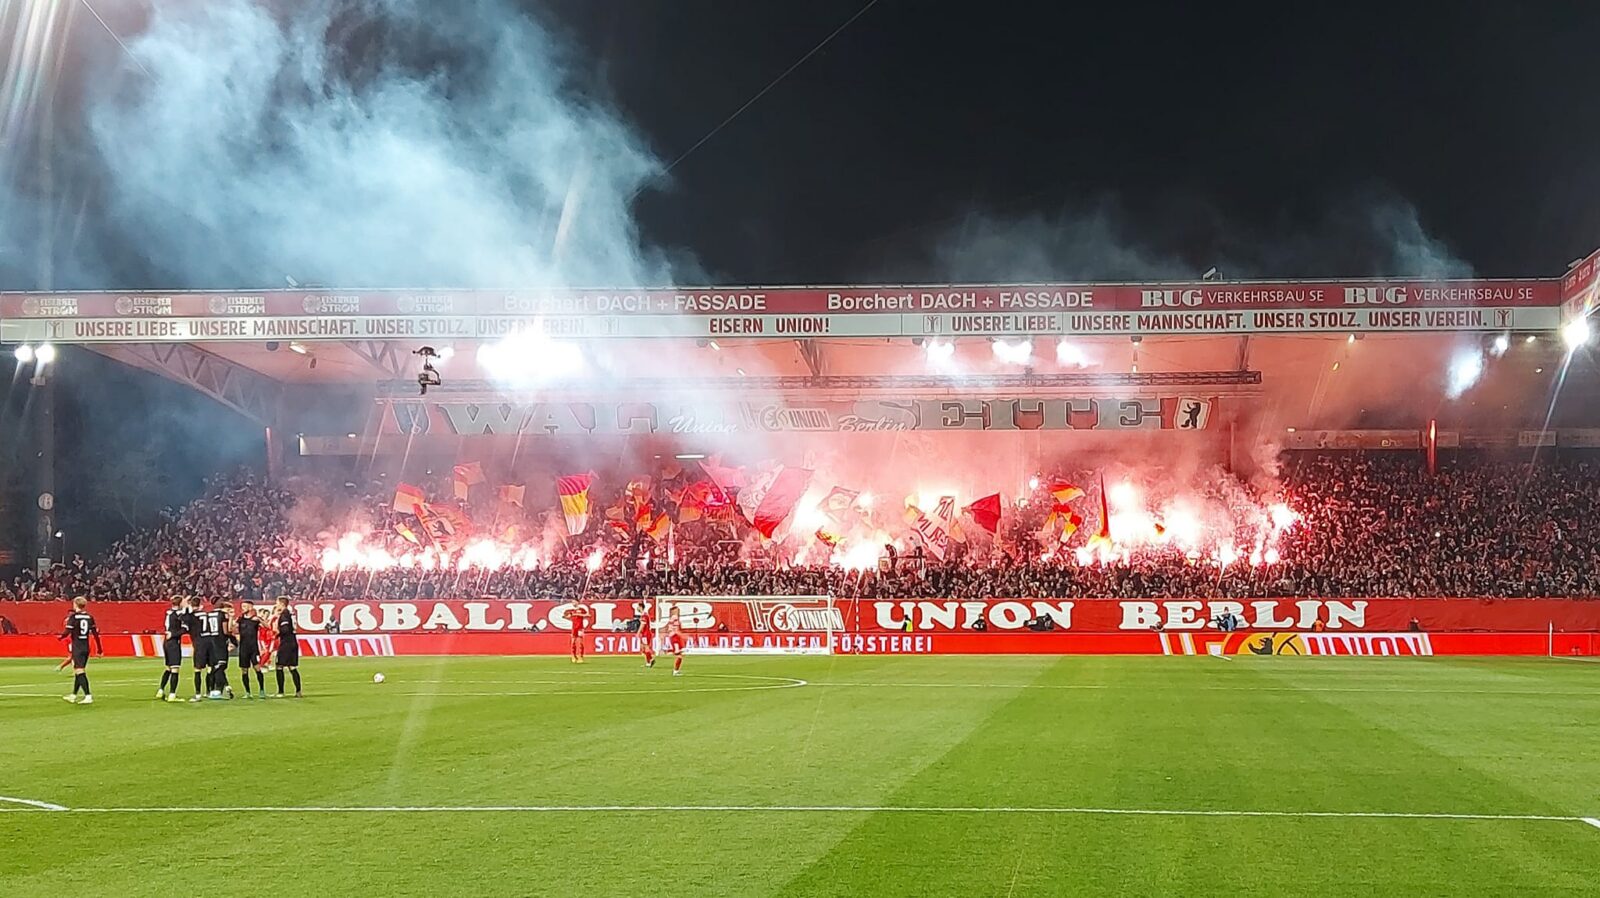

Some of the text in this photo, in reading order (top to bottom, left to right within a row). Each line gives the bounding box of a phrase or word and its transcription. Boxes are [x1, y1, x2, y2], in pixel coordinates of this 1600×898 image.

[504, 295, 590, 310] Borchert
[597, 295, 651, 311] DACH
[674, 295, 766, 311] FASSADE
[827, 291, 1093, 310] Borchert DACH + FASSADE
[1141, 290, 1324, 307] BUG VERKEHRSBAU SE
[1342, 287, 1533, 304] BUG VERKEHRSBAU SE
[40, 306, 78, 315] STROM
[133, 305, 172, 314] STROM
[227, 304, 265, 314] STROM
[321, 304, 360, 313] STROM
[76, 321, 133, 337] UNSERE
[137, 321, 182, 336] LIEBE.
[190, 320, 247, 336] UNSERE
[253, 320, 359, 336] MANNSCHAFT.
[366, 319, 414, 335] UNSER
[419, 319, 468, 334] STOLZ.
[710, 318, 830, 334] EISERN UNION!
[952, 310, 1488, 332] UNSERE LIEBE. UNSERE MANNSCHAFT. UNSER STOLZ. UNSER VEREIN.
[787, 409, 831, 429] UNION
[873, 601, 1074, 630] UNION
[1118, 600, 1369, 631] BERLIN
[80, 619, 88, 635] 9
